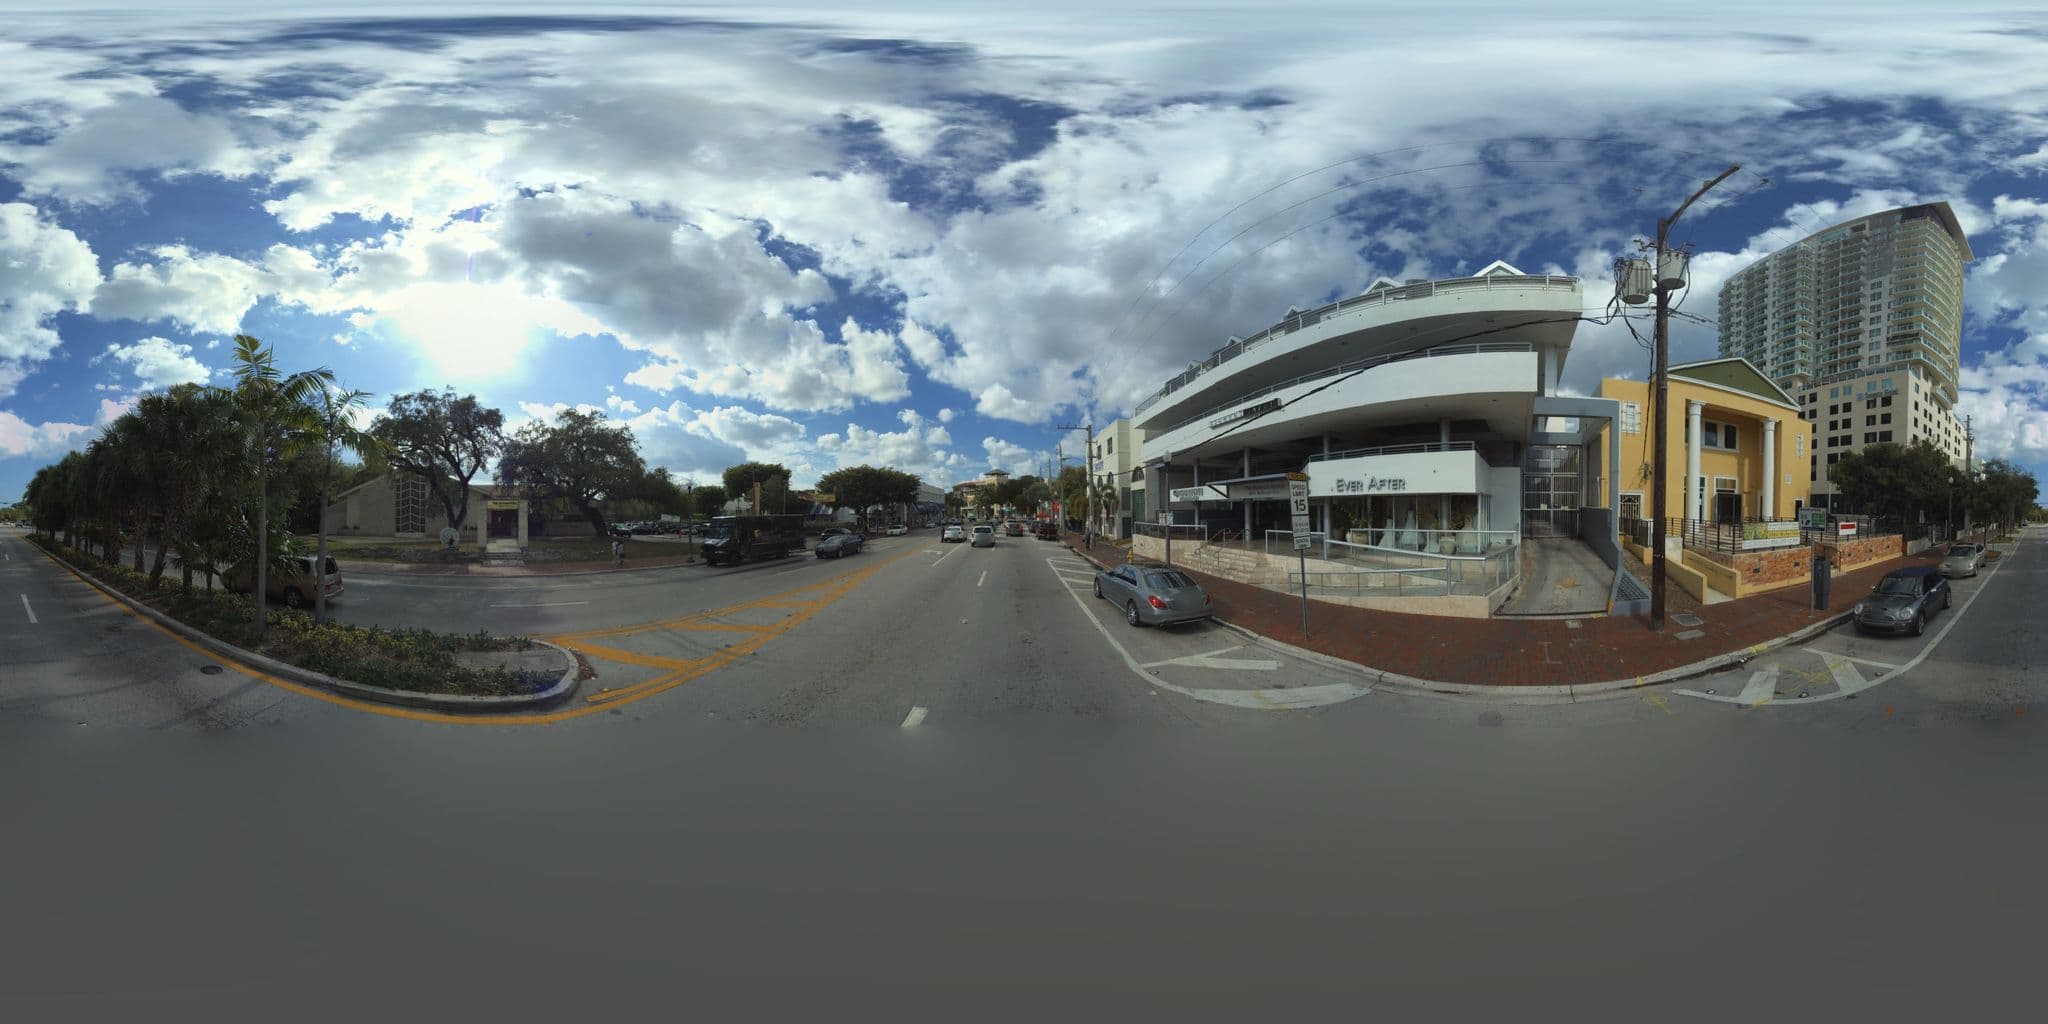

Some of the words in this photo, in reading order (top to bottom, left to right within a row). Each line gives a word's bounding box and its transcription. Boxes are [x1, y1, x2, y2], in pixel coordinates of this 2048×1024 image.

[1336, 478, 1363, 492] EVER
[1368, 476, 1406, 491] AFTER
[1294, 499, 1306, 512] 15
